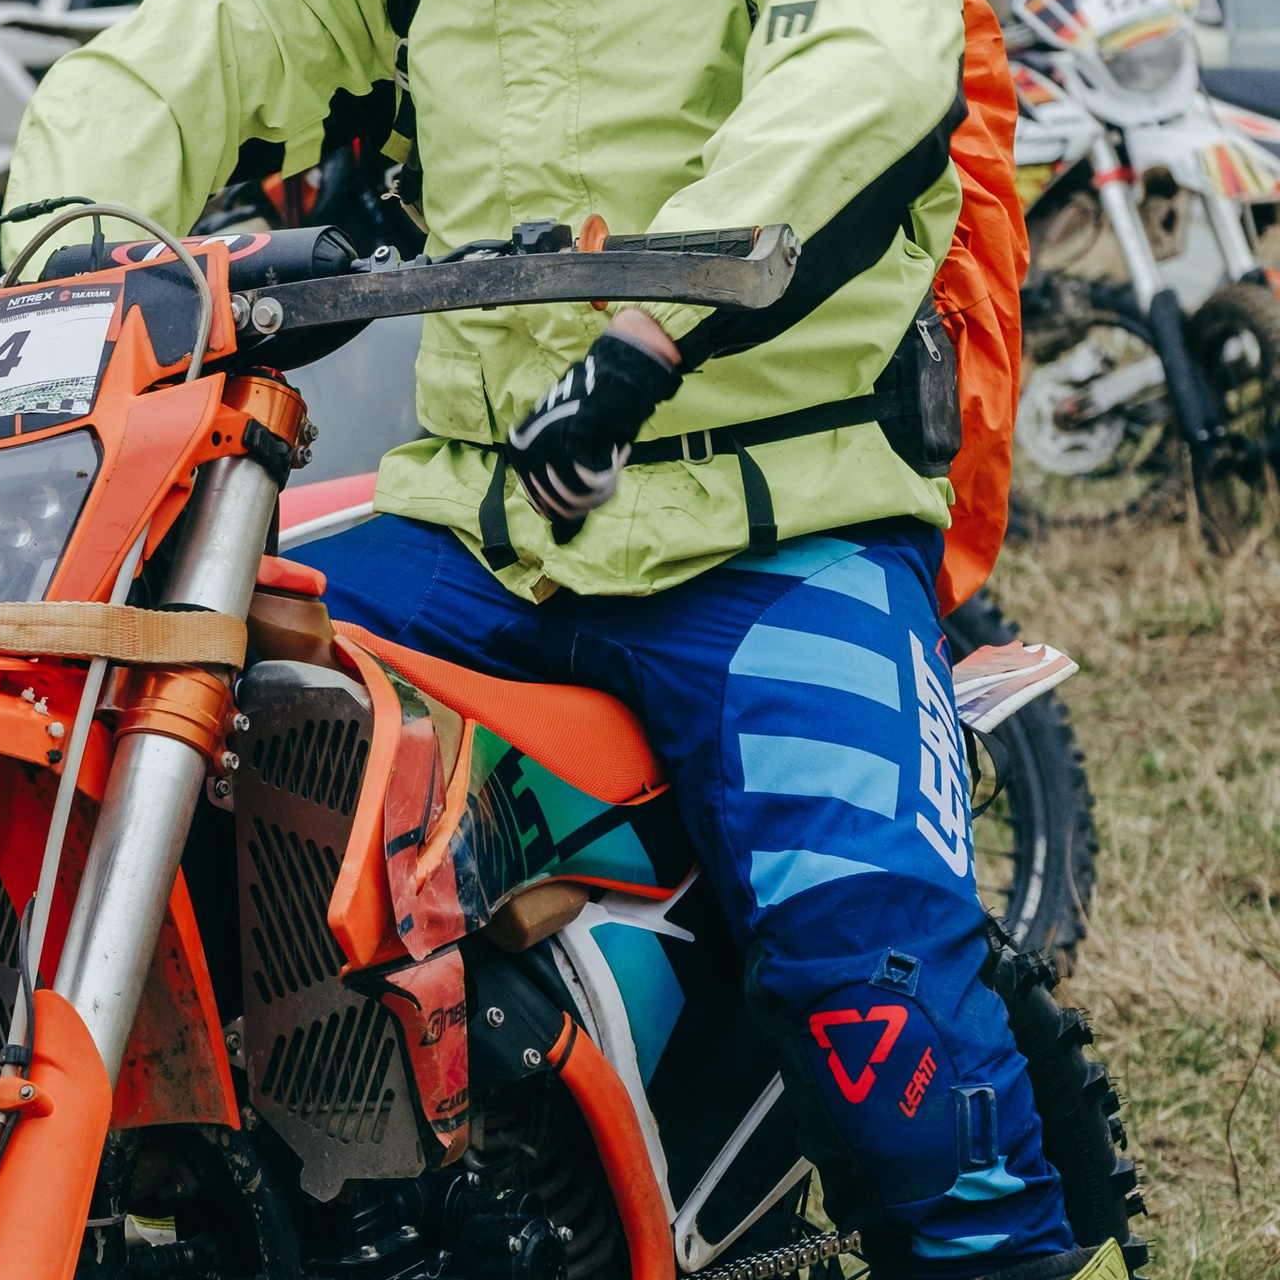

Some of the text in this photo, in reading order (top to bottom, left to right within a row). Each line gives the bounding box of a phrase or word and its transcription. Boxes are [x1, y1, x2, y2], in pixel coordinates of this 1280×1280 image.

[8, 291, 55, 307] NITREX
[71, 290, 110, 300] TAKAYAMA
[899, 1046, 938, 1118] LEATT
